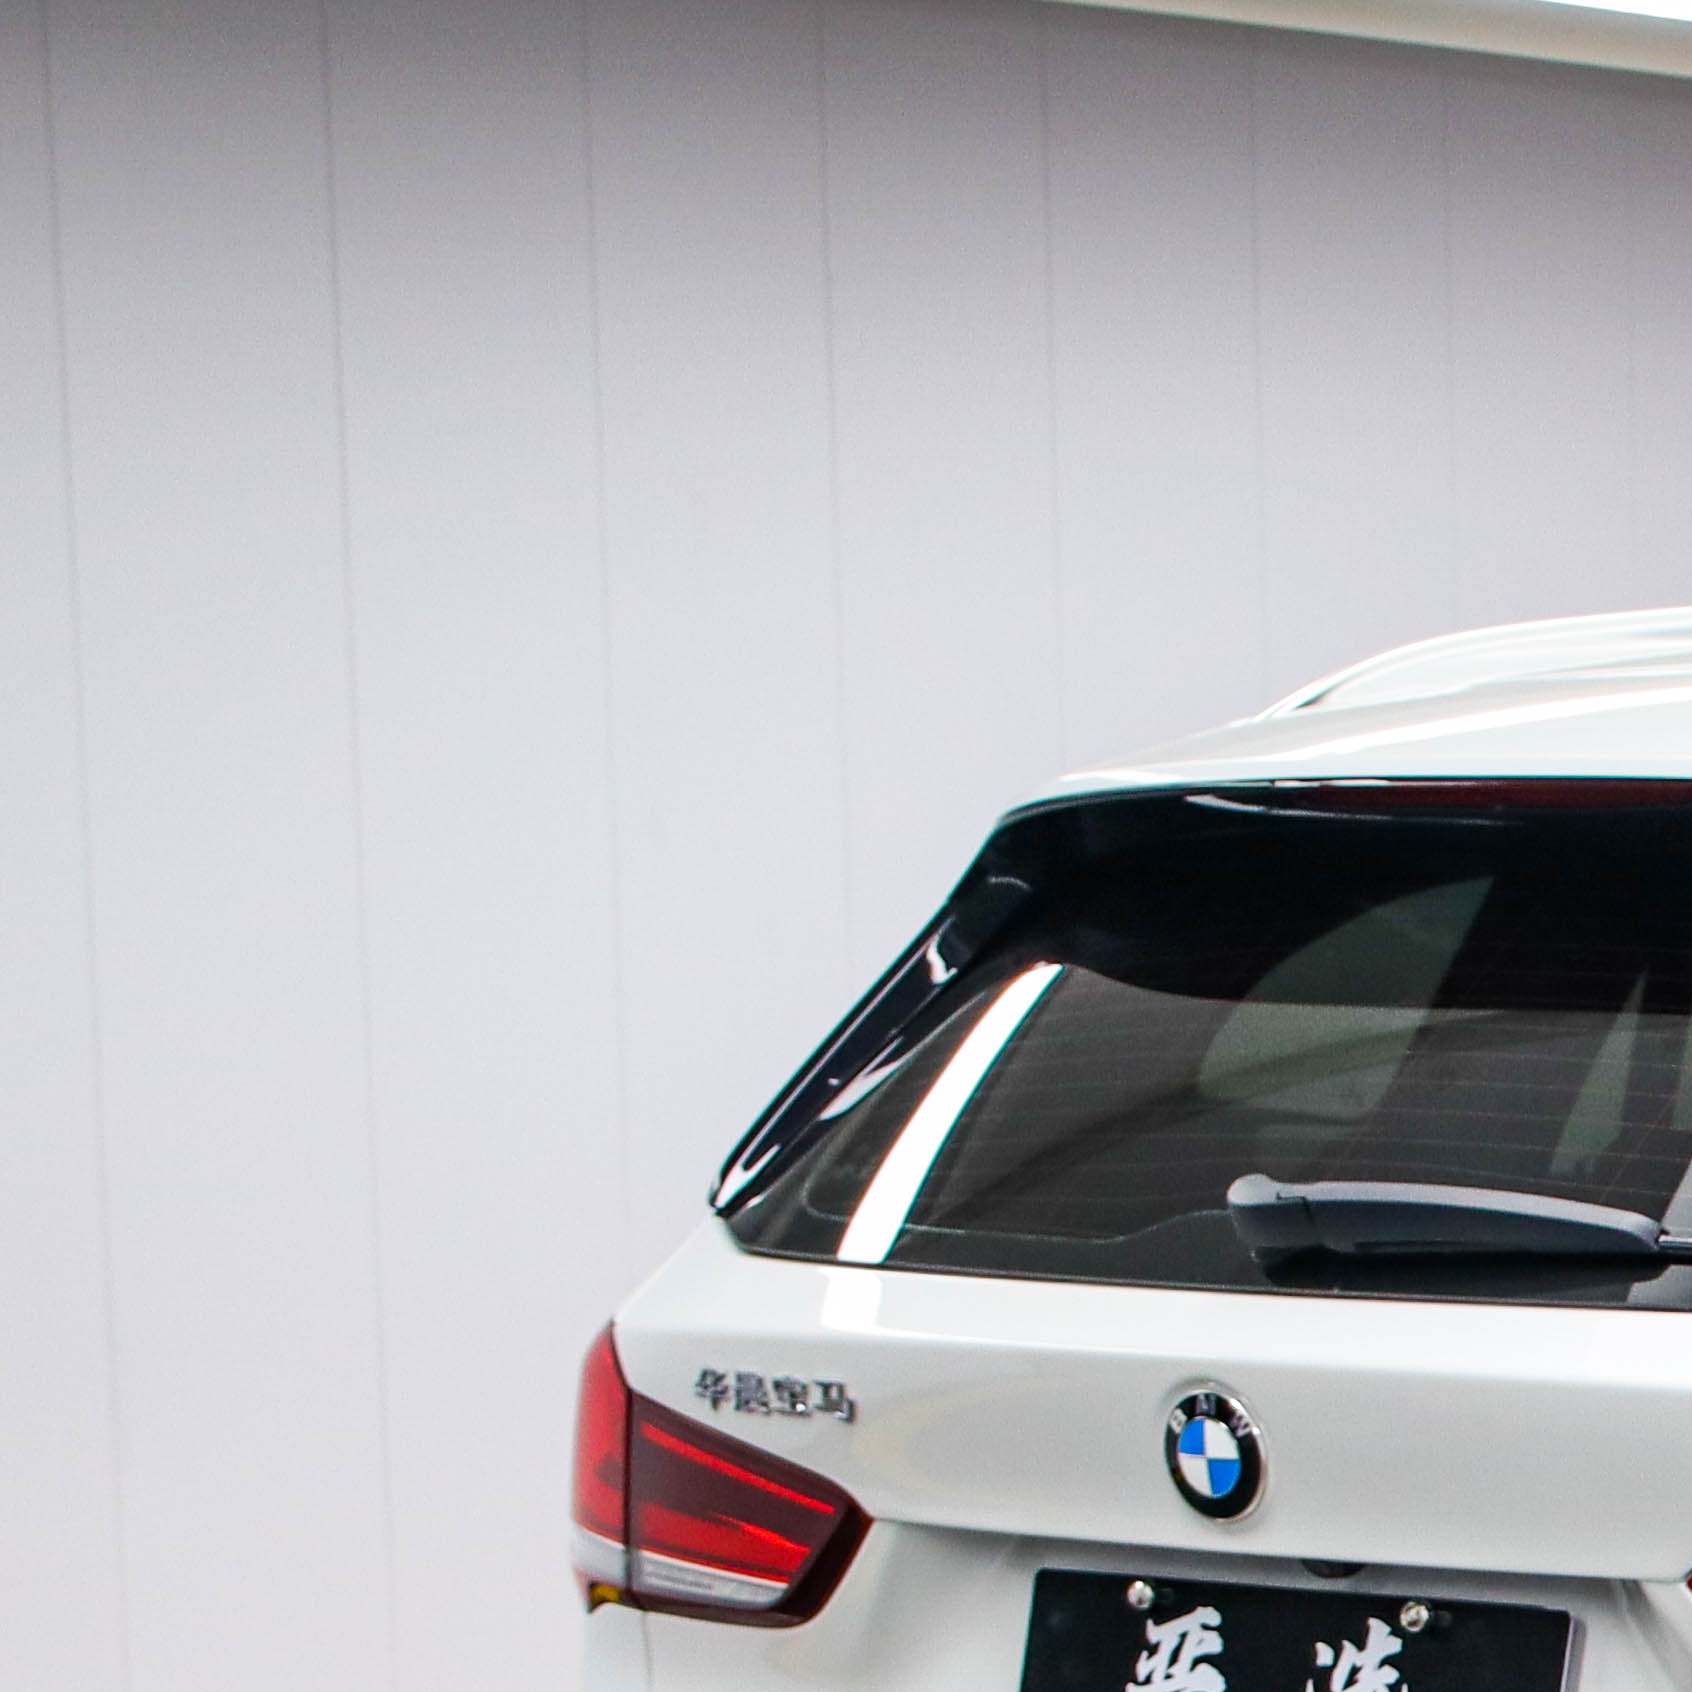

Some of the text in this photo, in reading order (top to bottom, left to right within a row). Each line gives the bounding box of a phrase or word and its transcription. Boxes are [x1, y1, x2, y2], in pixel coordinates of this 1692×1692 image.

[695, 1368, 856, 1424] 华晨宝马
[1168, 1393, 1252, 1438] BMW
